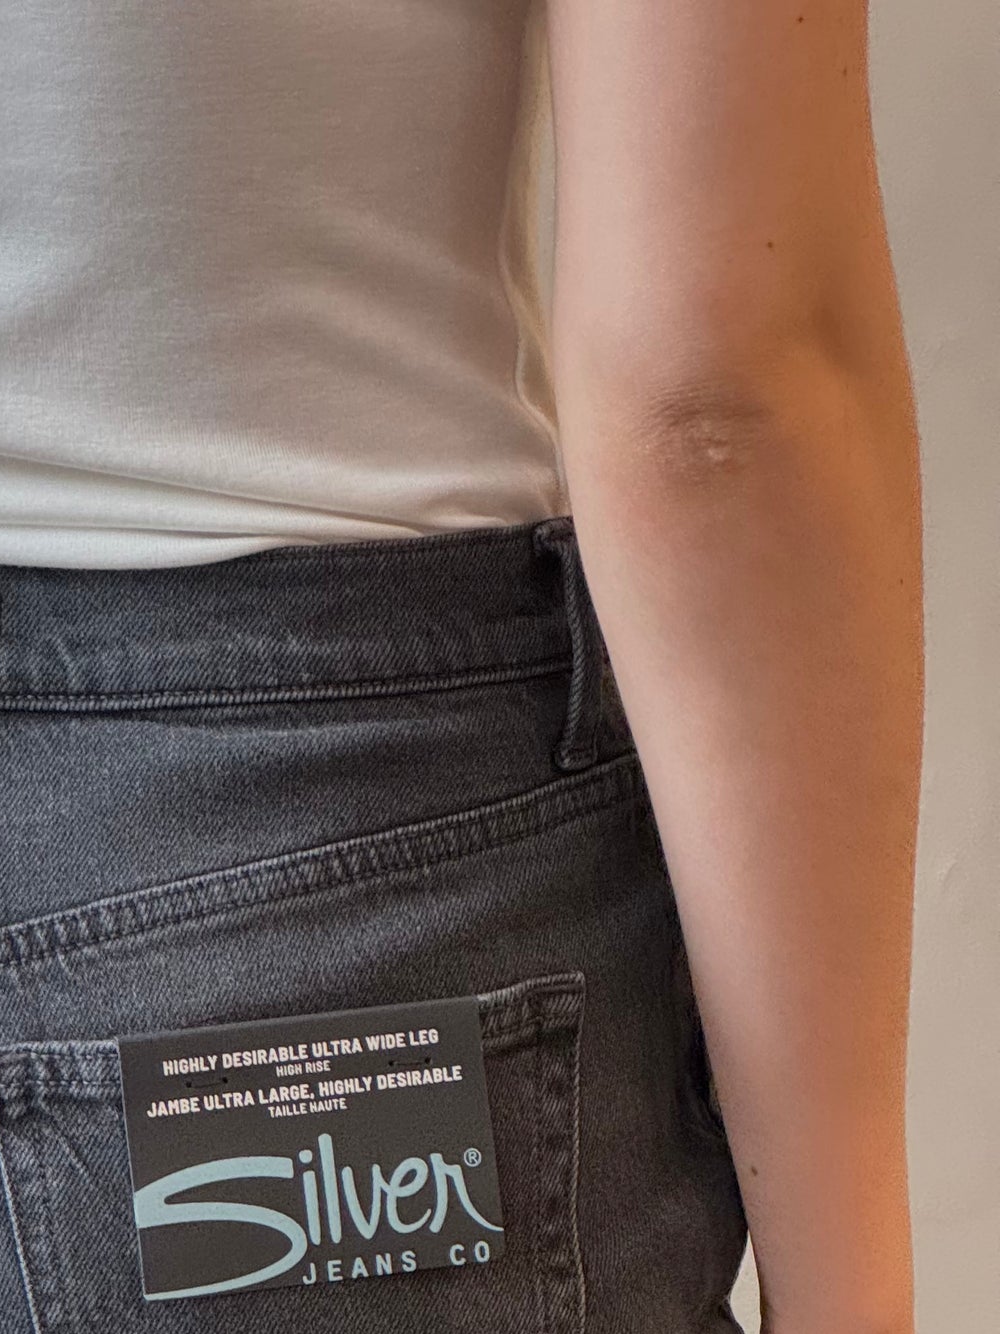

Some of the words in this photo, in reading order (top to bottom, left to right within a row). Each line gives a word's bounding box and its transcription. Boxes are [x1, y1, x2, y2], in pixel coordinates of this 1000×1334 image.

[162, 1054, 218, 1076] HIGHLY
[222, 1044, 308, 1069] DESIRABLE
[312, 1036, 362, 1060] ULTRA
[365, 1031, 405, 1052] WIDE
[409, 1028, 439, 1046] LEG
[276, 1063, 303, 1078] HIGH
[305, 1060, 331, 1075] RISE
[147, 1096, 200, 1118] JAMBE
[203, 1090, 254, 1111] ULTRA
[259, 1083, 315, 1105] LARGE,
[319, 1076, 373, 1098] HIGHLY
[377, 1065, 463, 1091] DESIRABLE
[268, 1102, 307, 1119] TAILLE
[309, 1097, 347, 1114] HAUTE
[302, 1250, 417, 1285] JEANS
[449, 1240, 491, 1267] CO
